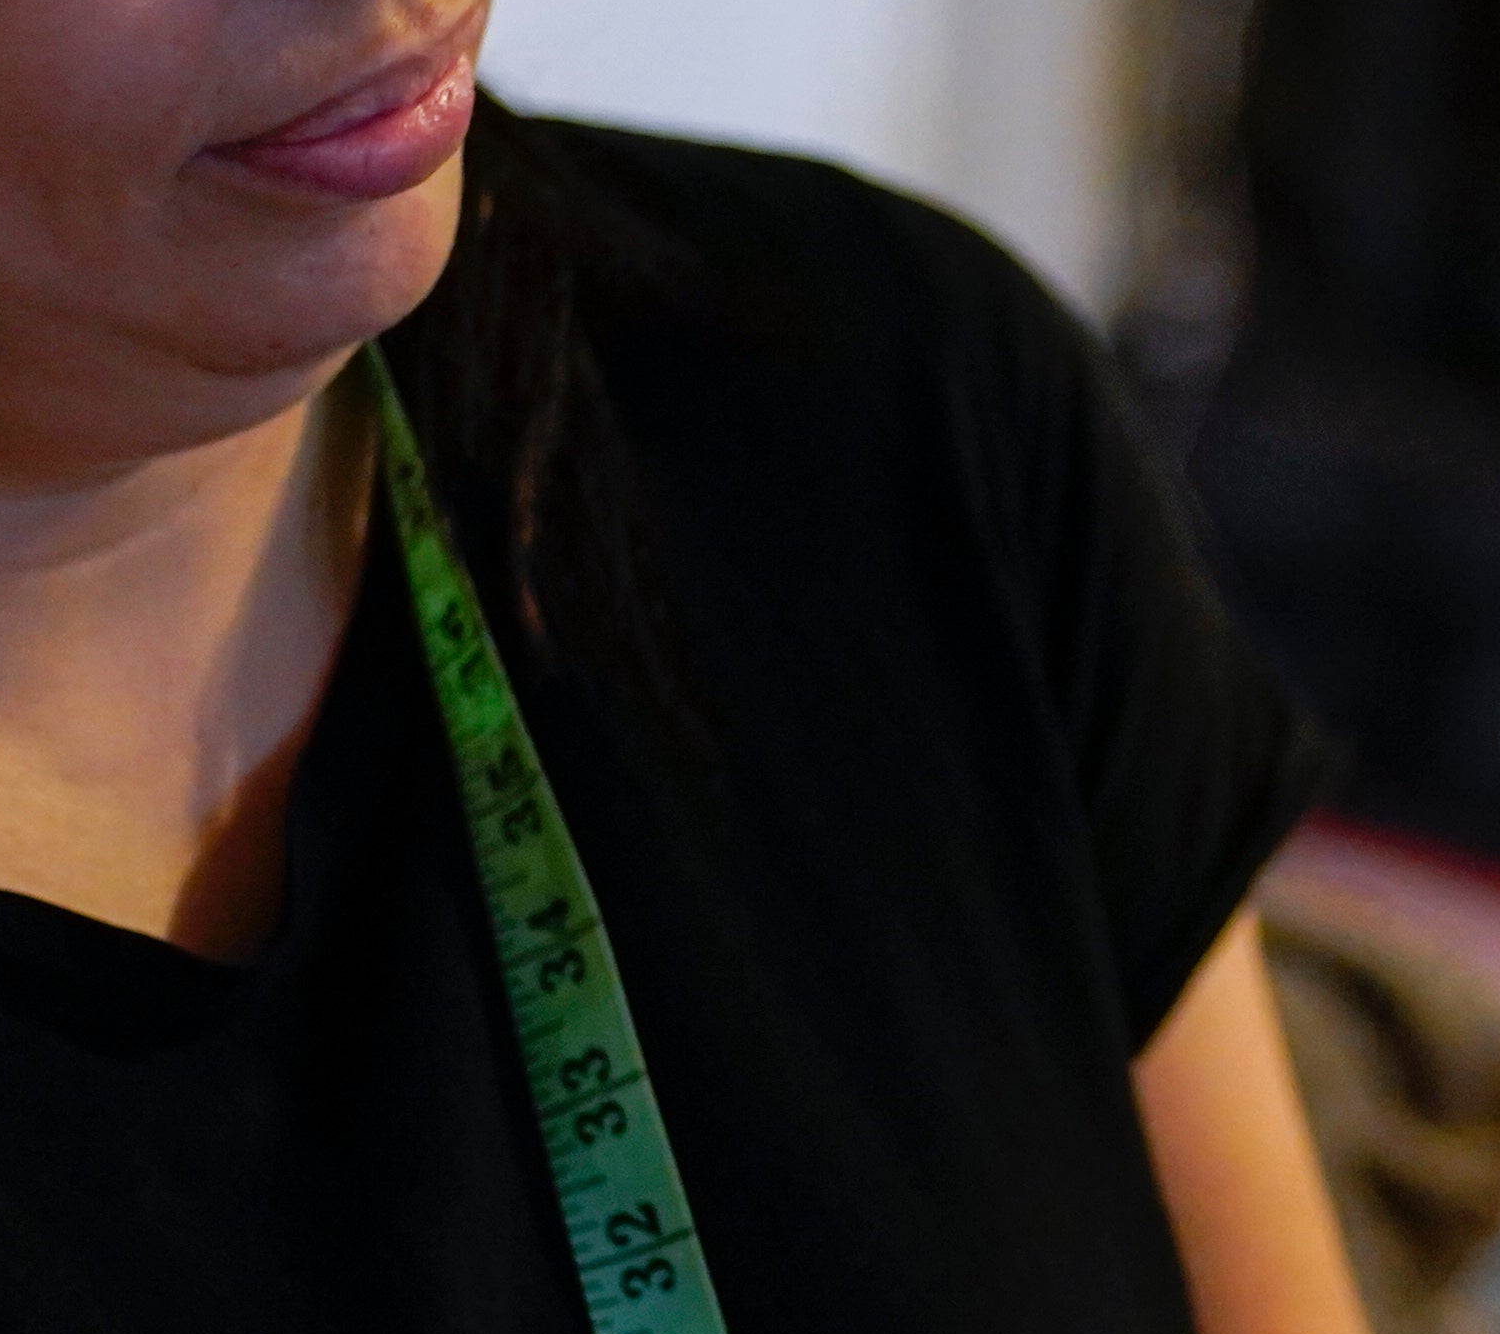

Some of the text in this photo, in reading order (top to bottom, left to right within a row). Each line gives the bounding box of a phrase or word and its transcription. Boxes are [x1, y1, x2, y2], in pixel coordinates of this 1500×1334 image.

[525, 897, 589, 996] 34
[561, 1046, 629, 1148] 33
[606, 1202, 678, 1302] 32
